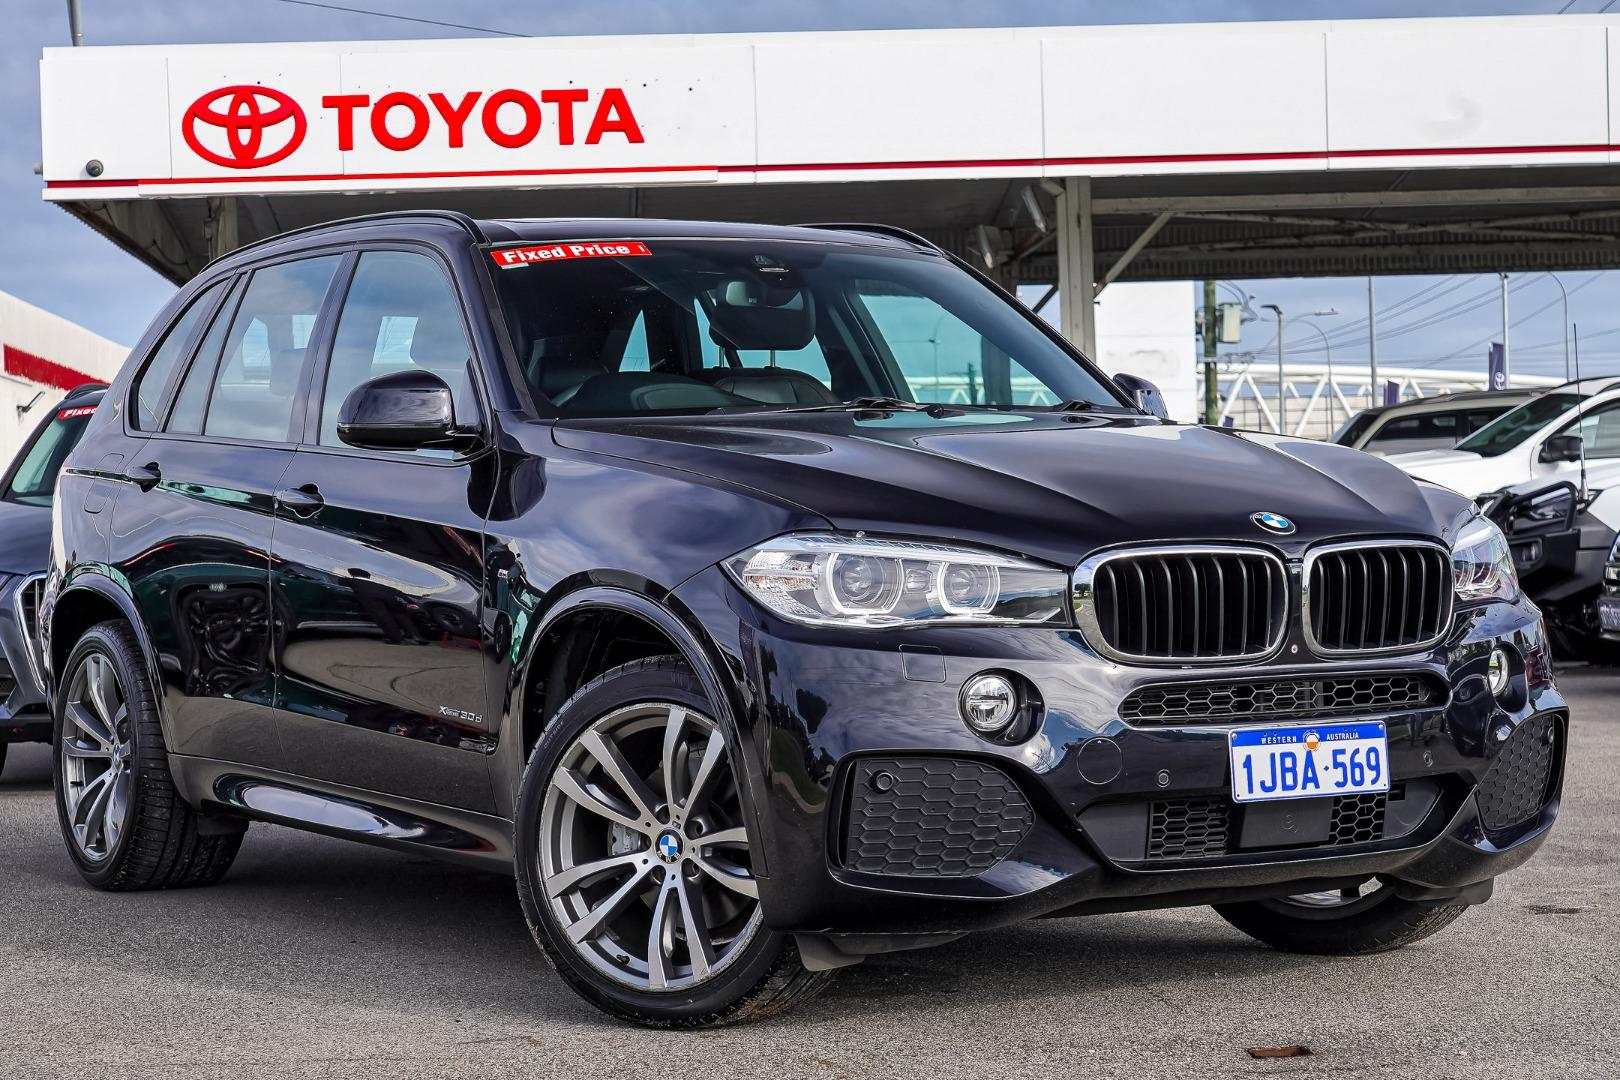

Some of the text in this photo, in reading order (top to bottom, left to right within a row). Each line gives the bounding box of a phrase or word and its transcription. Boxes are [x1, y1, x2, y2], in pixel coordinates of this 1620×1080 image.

[322, 88, 645, 152] TOYOTA
[502, 245, 631, 263] Fixed Price
[1261, 732, 1360, 744] WESTERN AUSTRALIA
